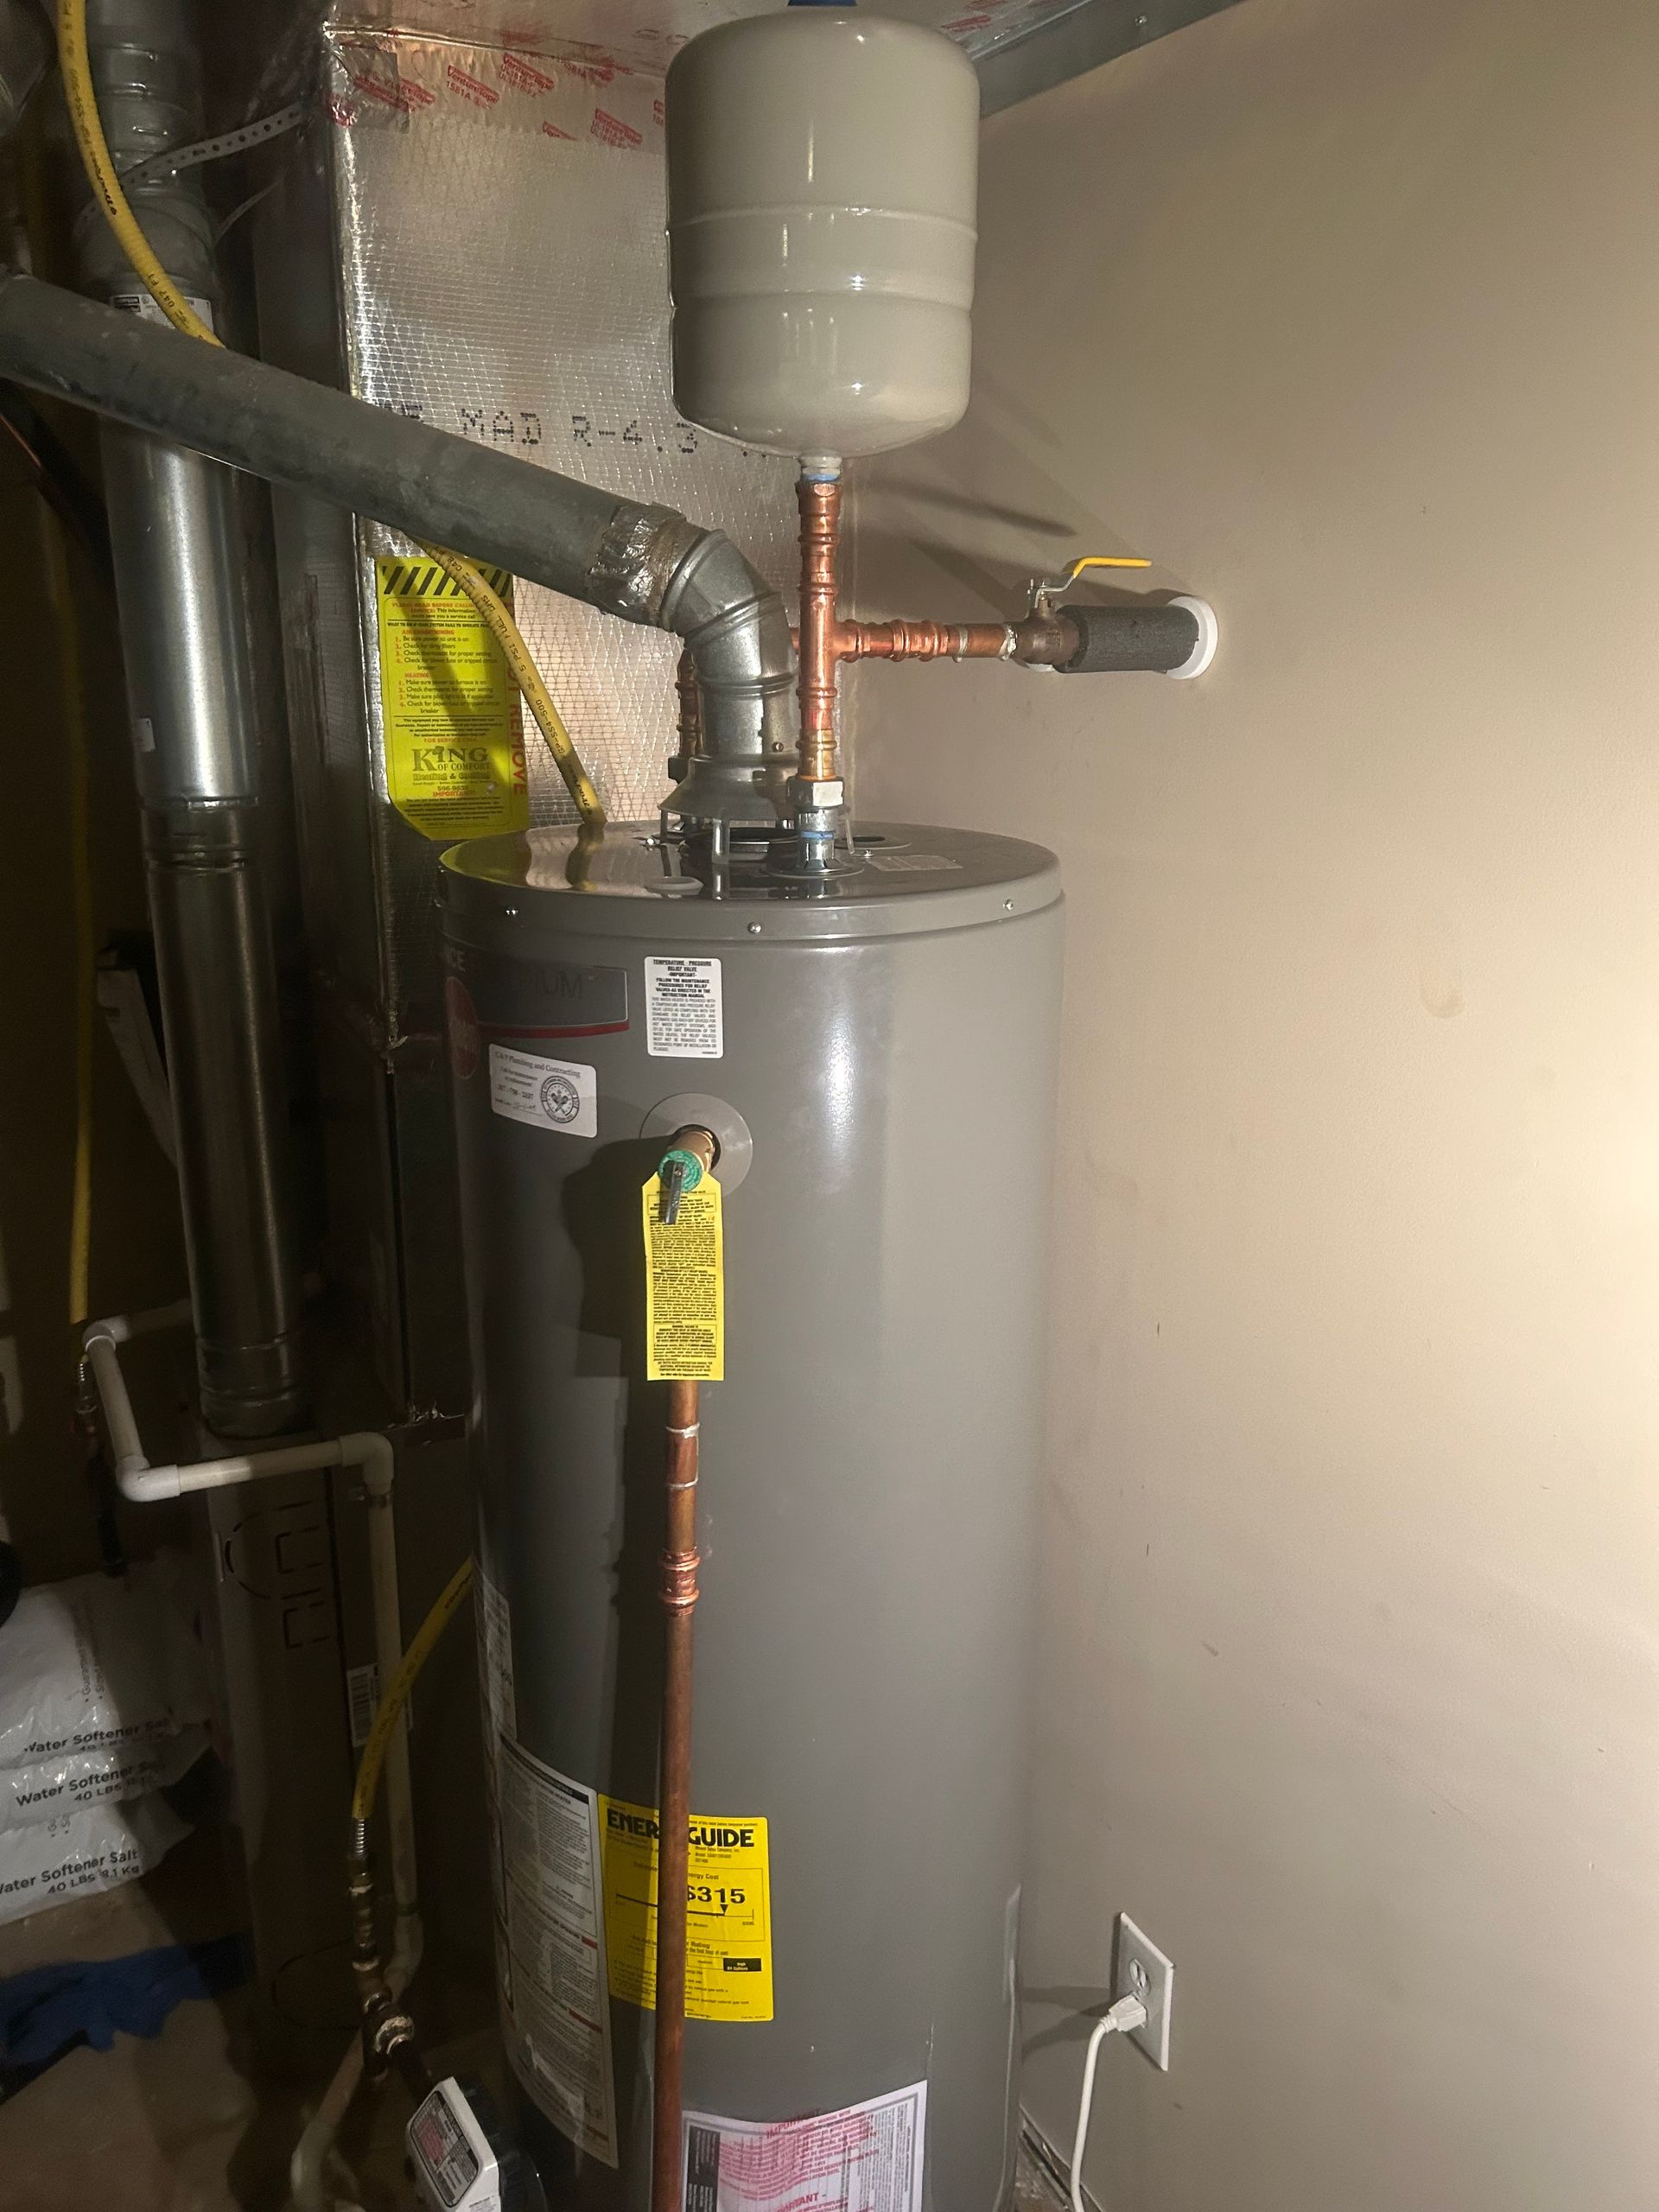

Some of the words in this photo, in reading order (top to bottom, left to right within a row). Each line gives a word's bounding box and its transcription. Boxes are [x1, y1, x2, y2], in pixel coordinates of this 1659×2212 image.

[496, 614, 511, 639] FUEL
[508, 642, 522, 665] PSI
[412, 746, 488, 771] KING
[510, 704, 527, 795] REMOVE
[546, 1064, 581, 1078] Contracting
[73, 1724, 138, 1745] Softener
[16, 1785, 64, 1806] Water
[69, 1766, 132, 1791] Softener
[74, 1790, 92, 1801] 40
[41, 1855, 105, 1881] Softener
[109, 1847, 138, 1862] Salt
[47, 1882, 66, 1894] 40
[687, 1885, 745, 1904] $315
